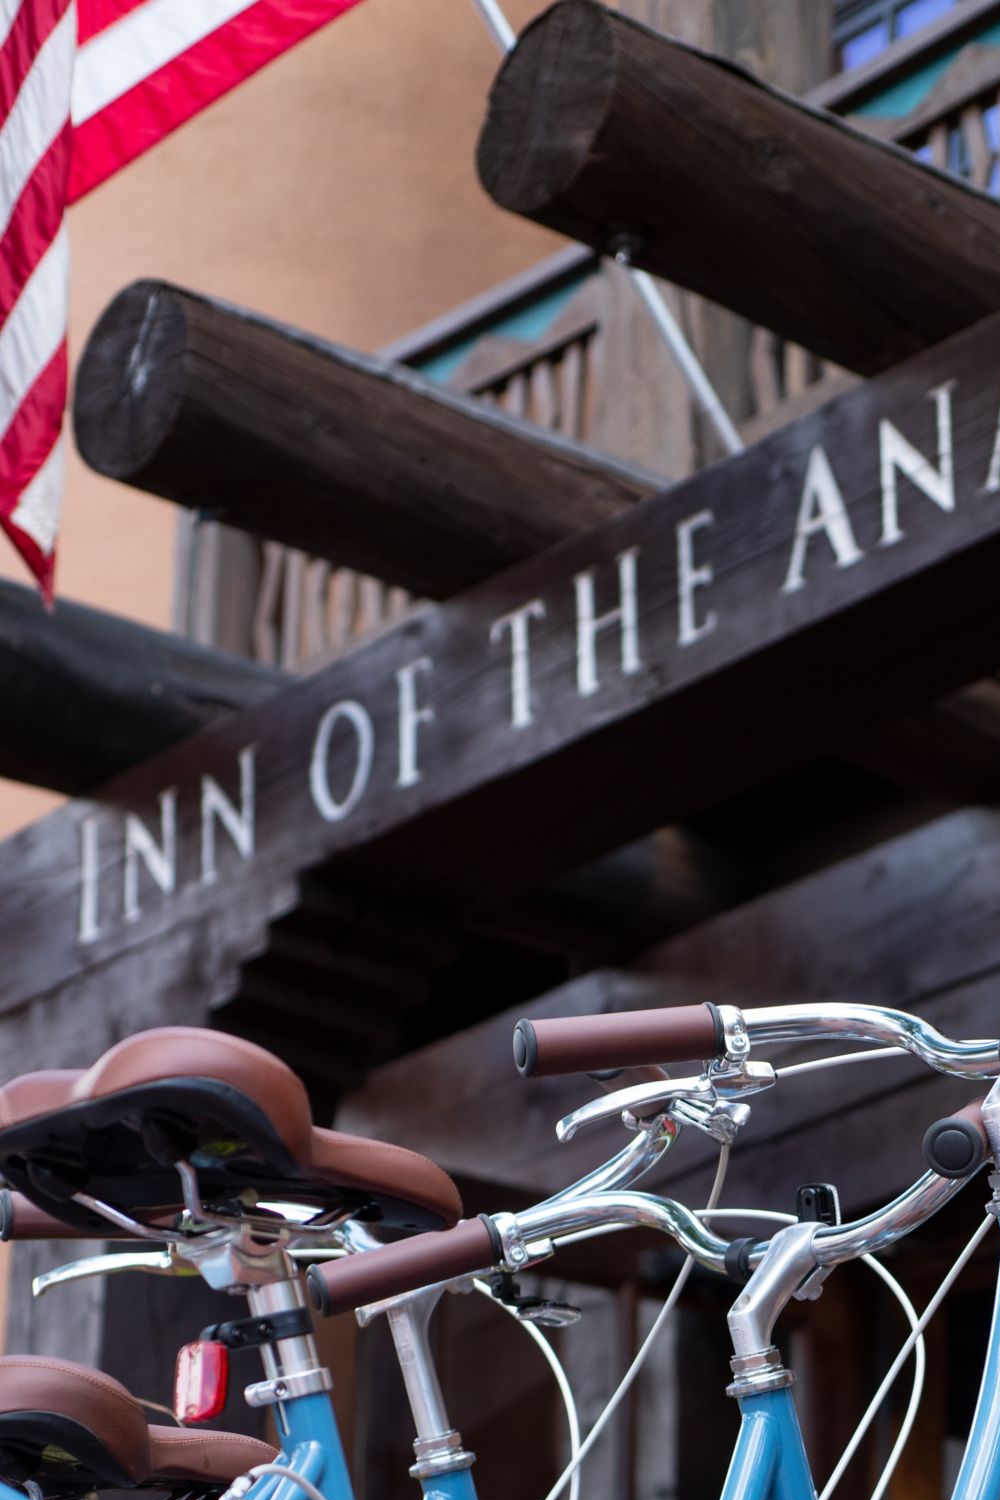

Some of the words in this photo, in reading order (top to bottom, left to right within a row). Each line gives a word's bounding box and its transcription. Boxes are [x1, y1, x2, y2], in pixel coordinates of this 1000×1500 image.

[78, 745, 257, 946] INN
[310, 656, 436, 823] OF
[489, 507, 717, 728] THE
